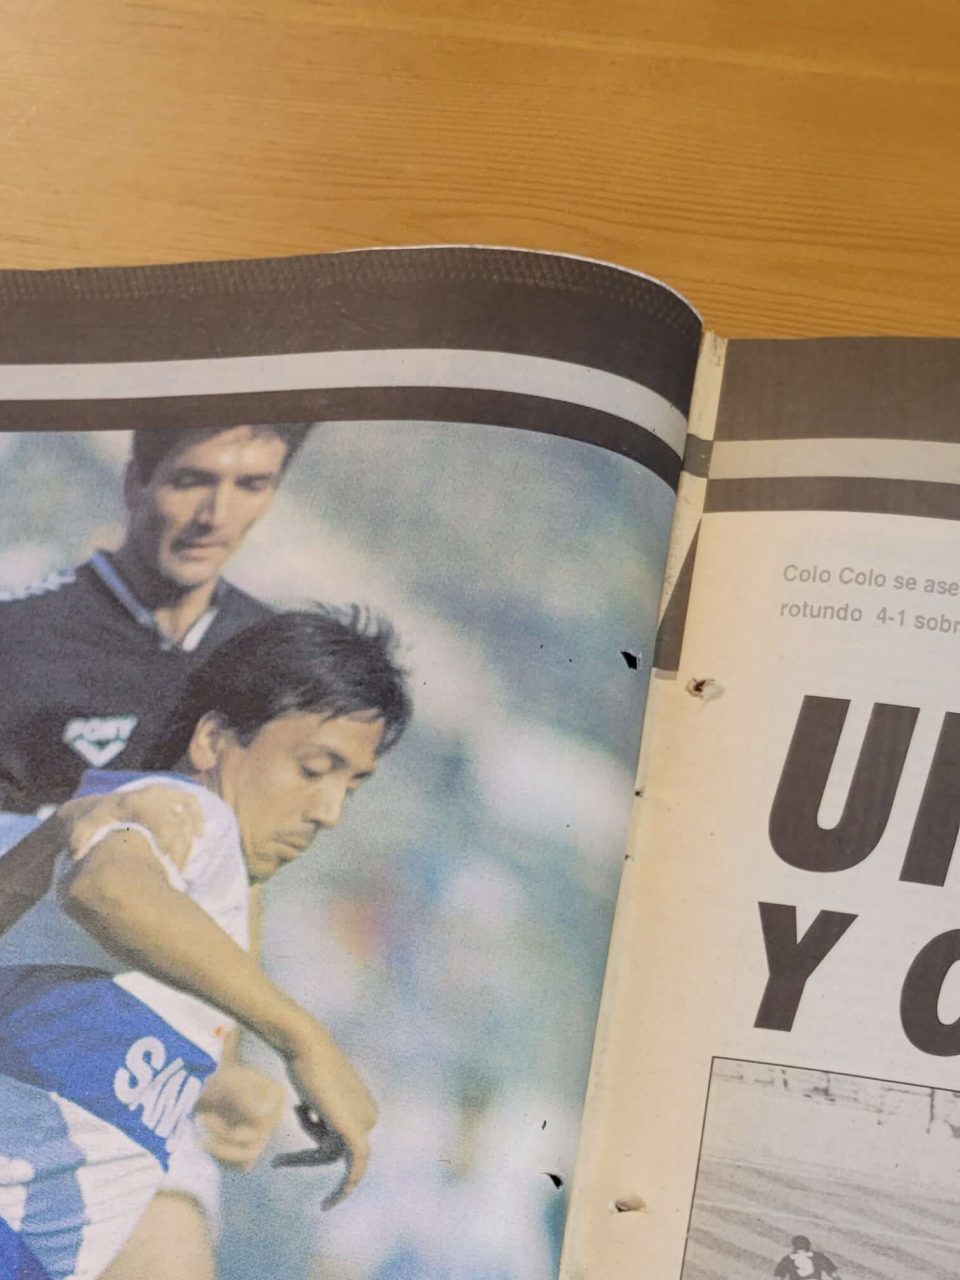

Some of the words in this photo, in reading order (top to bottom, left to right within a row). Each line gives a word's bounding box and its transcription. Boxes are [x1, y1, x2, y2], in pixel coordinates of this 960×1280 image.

[783, 564, 831, 583] Colo
[839, 567, 886, 587] Colo
[893, 575, 917, 591] se
[924, 578, 959, 596] ase
[780, 602, 862, 622] rotundo
[876, 606, 905, 627] 4-1
[753, 901, 859, 1032] Y
